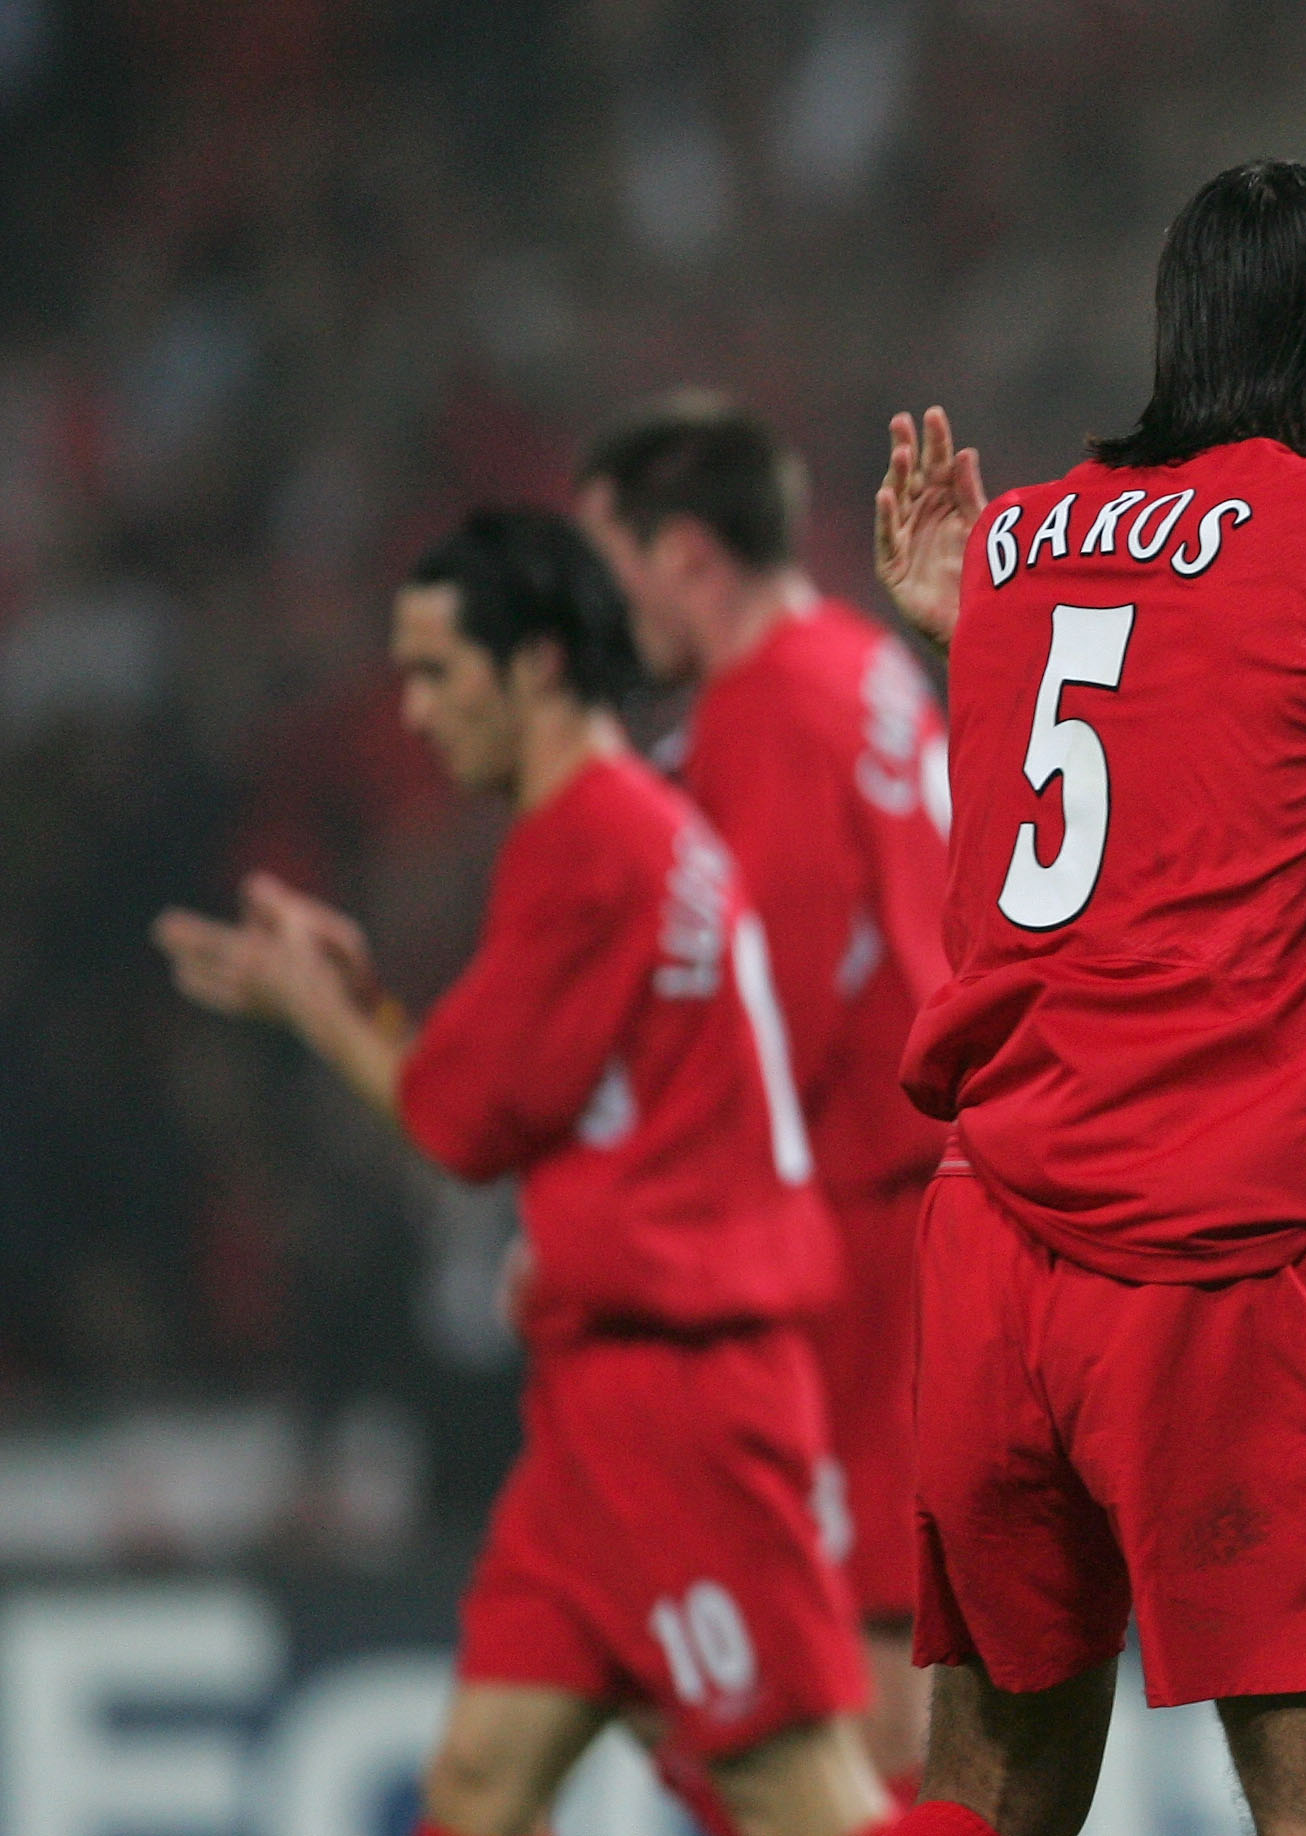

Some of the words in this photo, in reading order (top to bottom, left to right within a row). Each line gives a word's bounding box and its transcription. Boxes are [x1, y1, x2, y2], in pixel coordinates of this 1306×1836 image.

[986, 488, 1253, 588] BAROS
[998, 603, 1135, 932] 5
[650, 1579, 758, 1705] 10
